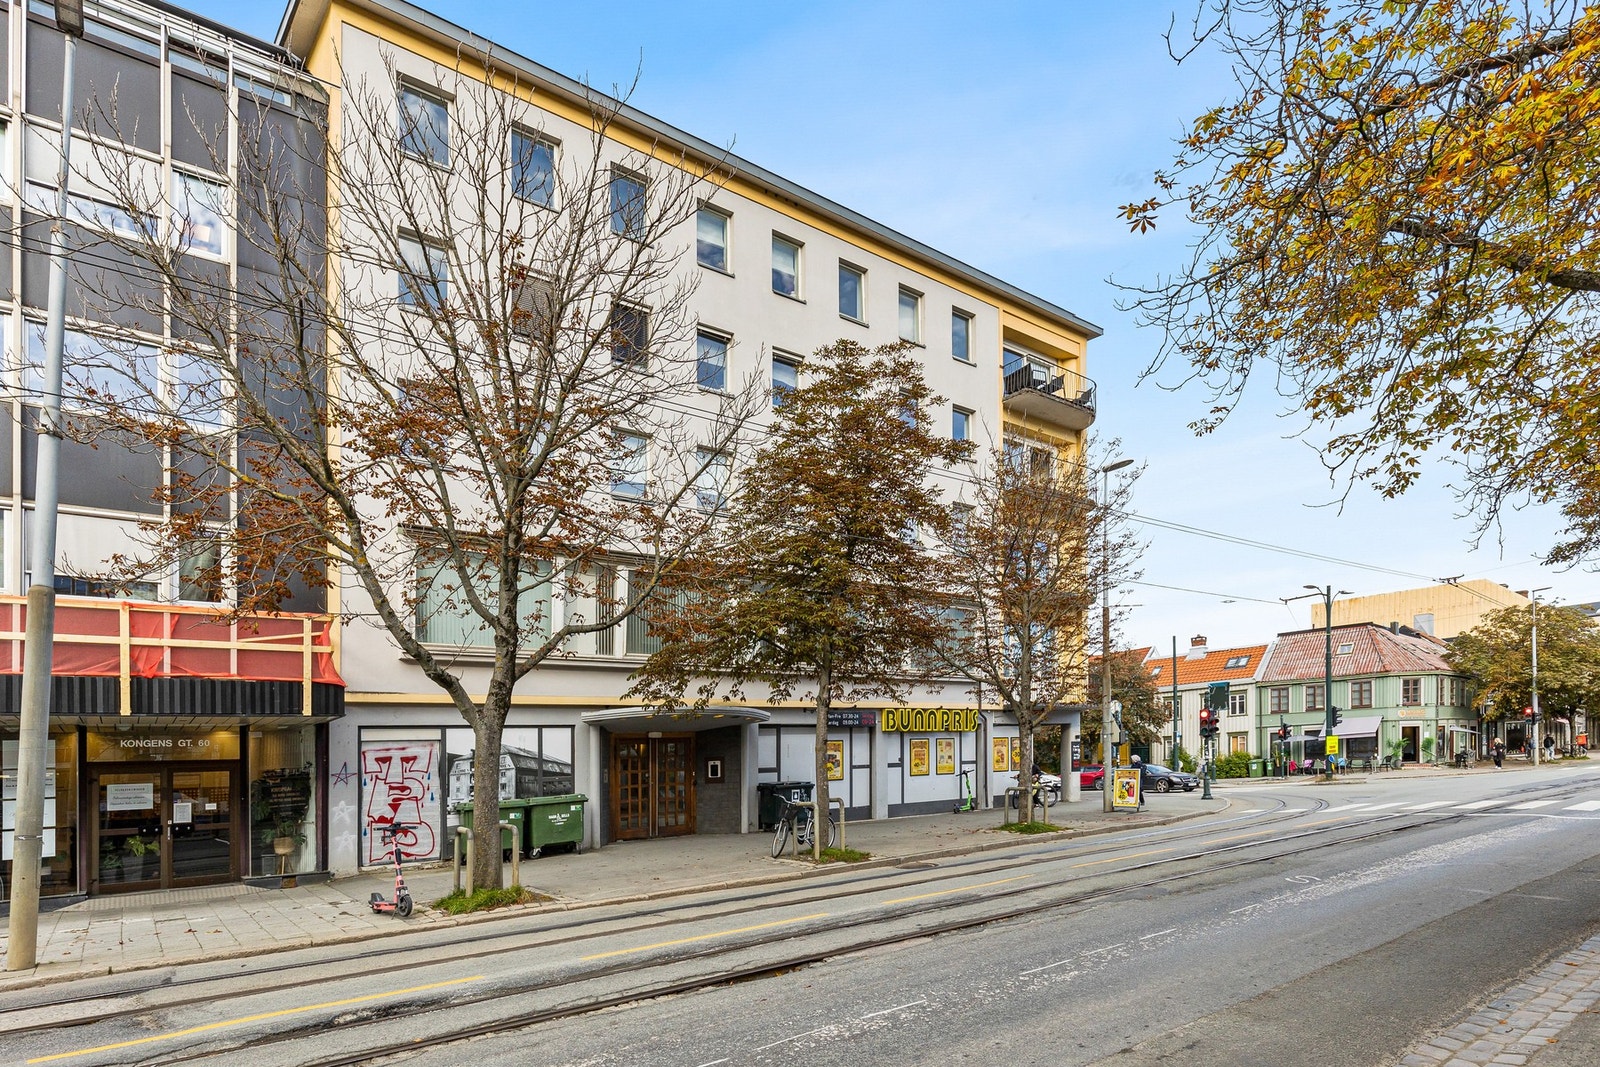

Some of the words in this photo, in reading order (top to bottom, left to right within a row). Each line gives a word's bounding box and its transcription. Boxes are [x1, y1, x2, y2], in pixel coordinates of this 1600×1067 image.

[882, 708, 979, 732] BUNNPRIS
[120, 739, 173, 748] KONGENS
[177, 739, 194, 748] GT.
[198, 739, 210, 747] 60
